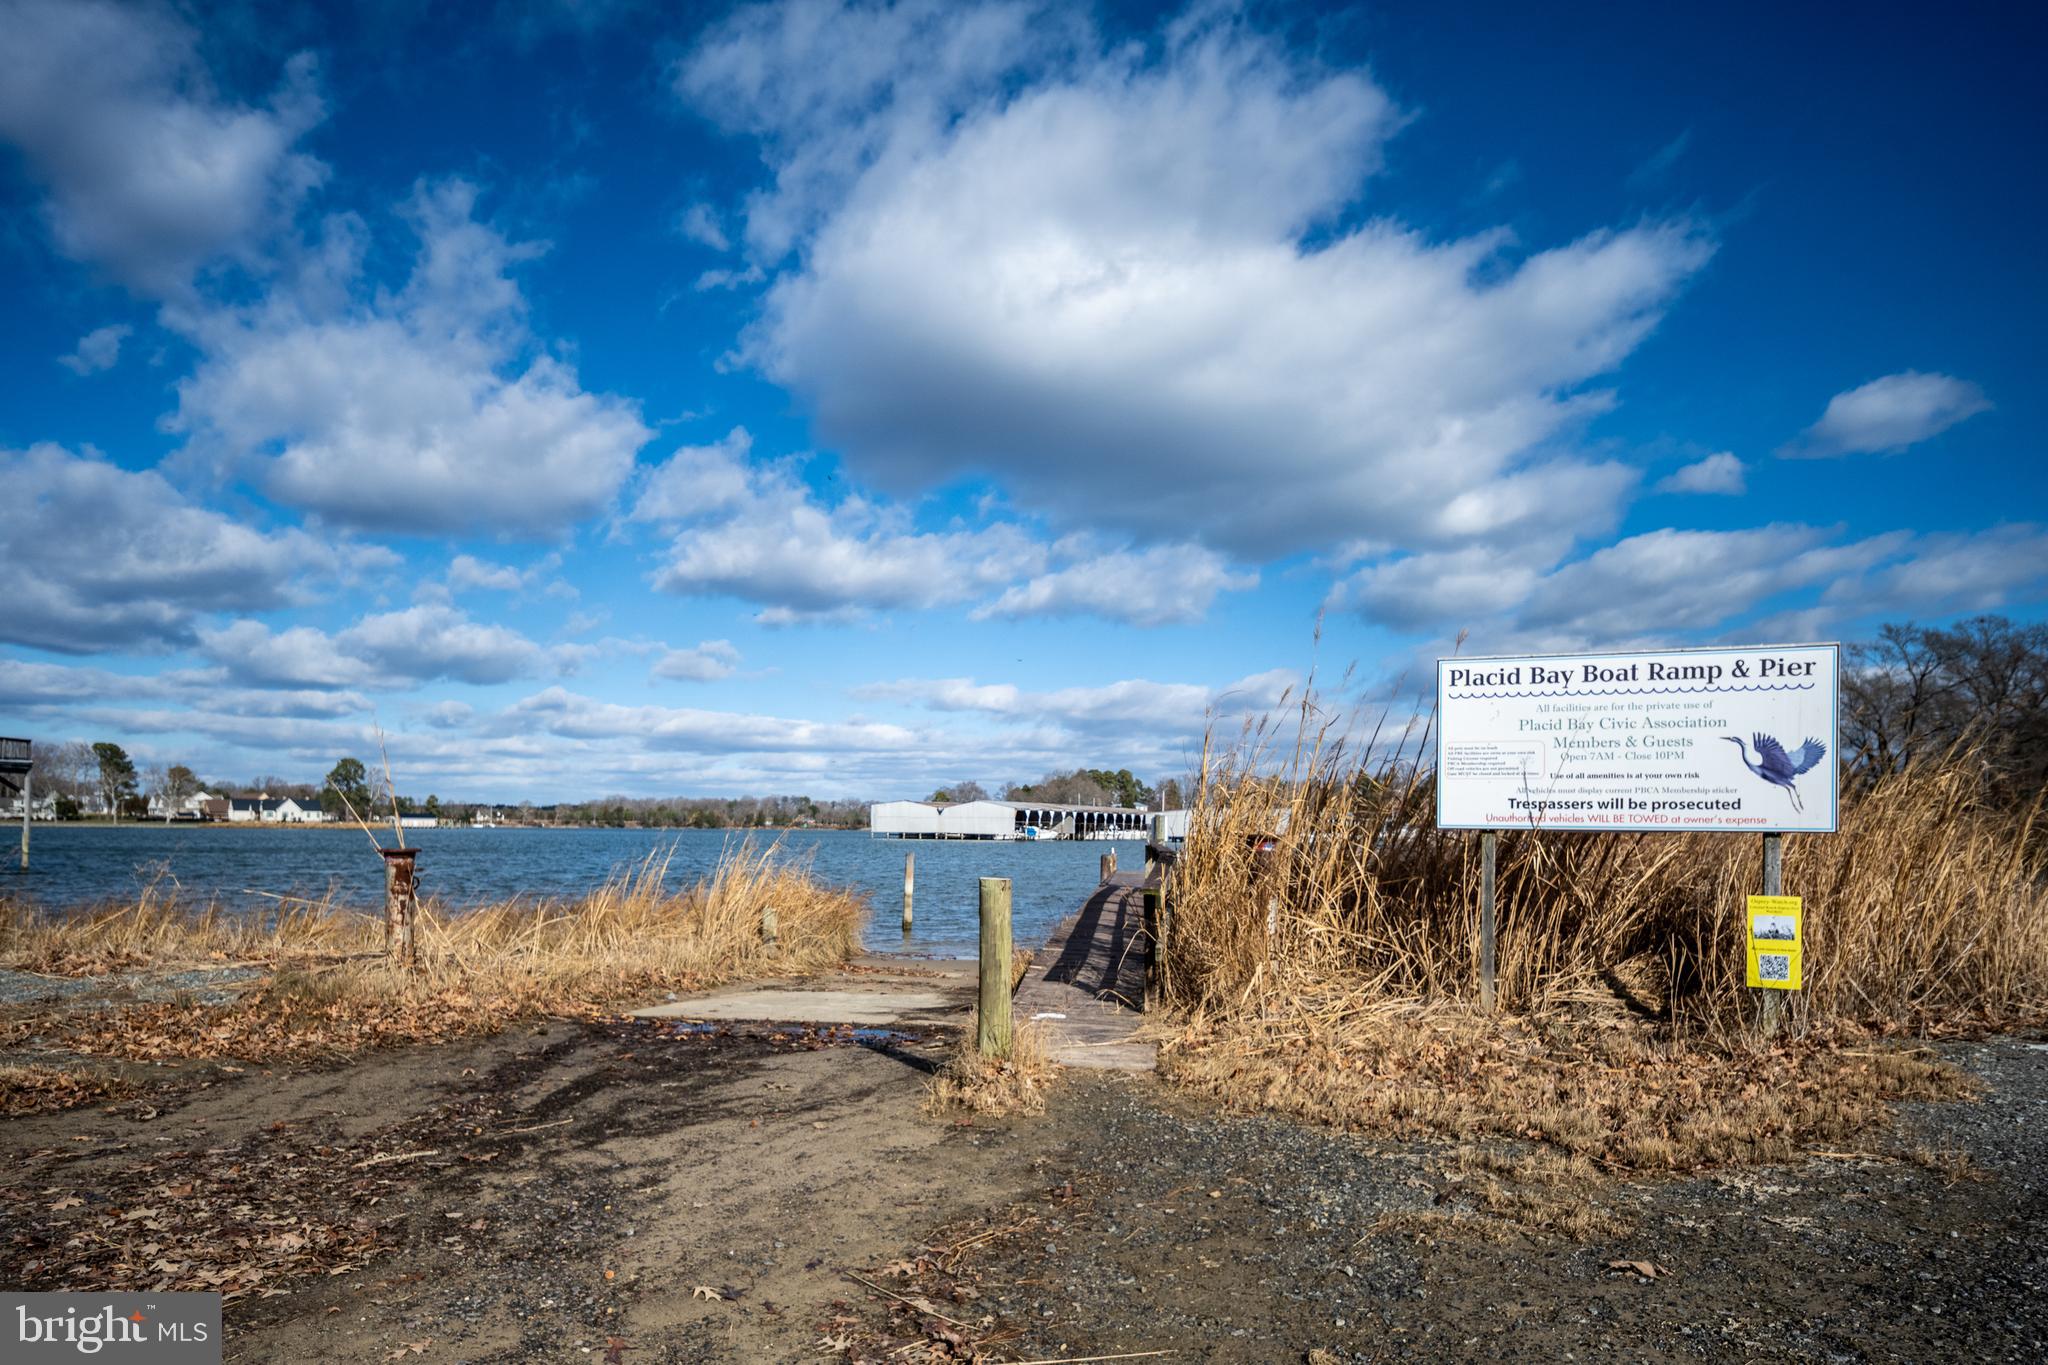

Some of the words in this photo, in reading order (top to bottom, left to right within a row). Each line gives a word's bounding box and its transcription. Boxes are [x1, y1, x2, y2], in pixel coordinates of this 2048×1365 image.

[1449, 667, 1521, 687] Placid
[1529, 667, 1575, 689] Bay
[1582, 663, 1639, 684] Boat
[1648, 662, 1722, 685] Ramp
[1731, 659, 1750, 678] &
[1759, 657, 1817, 678] Pier
[1536, 704, 1550, 713] All
[1553, 703, 1591, 713] facilities
[1611, 703, 1625, 712] for
[1627, 702, 1643, 711] the
[1646, 701, 1680, 713] private
[1703, 700, 1713, 709] of
[1519, 718, 1562, 731] Placid
[1568, 718, 1594, 733] Bay
[1599, 717, 1637, 730] Civic
[1642, 716, 1727, 729] Association
[1553, 736, 1621, 749] Members
[1625, 735, 1638, 748] &
[1643, 735, 1694, 748] Guests
[1560, 752, 1587, 763] Open
[1590, 751, 1614, 761] 7AM
[1625, 751, 1652, 761] Close
[1655, 751, 1685, 760] 10PM
[1578, 787, 1603, 796] display
[1661, 786, 1710, 796] Membership
[1712, 786, 1738, 794] sticker
[1508, 798, 1593, 812] Trespassers
[1597, 797, 1624, 809] will
[1628, 797, 1647, 810] be
[1651, 797, 1741, 812] prosecuted
[1549, 813, 1585, 823] vehicles
[1587, 814, 1612, 823] WILL
[1613, 814, 1625, 823] BE
[1628, 814, 1668, 823] TOWED
[1671, 816, 1681, 824] at
[1683, 815, 1723, 824] owner's
[1725, 817, 1767, 826] expense
